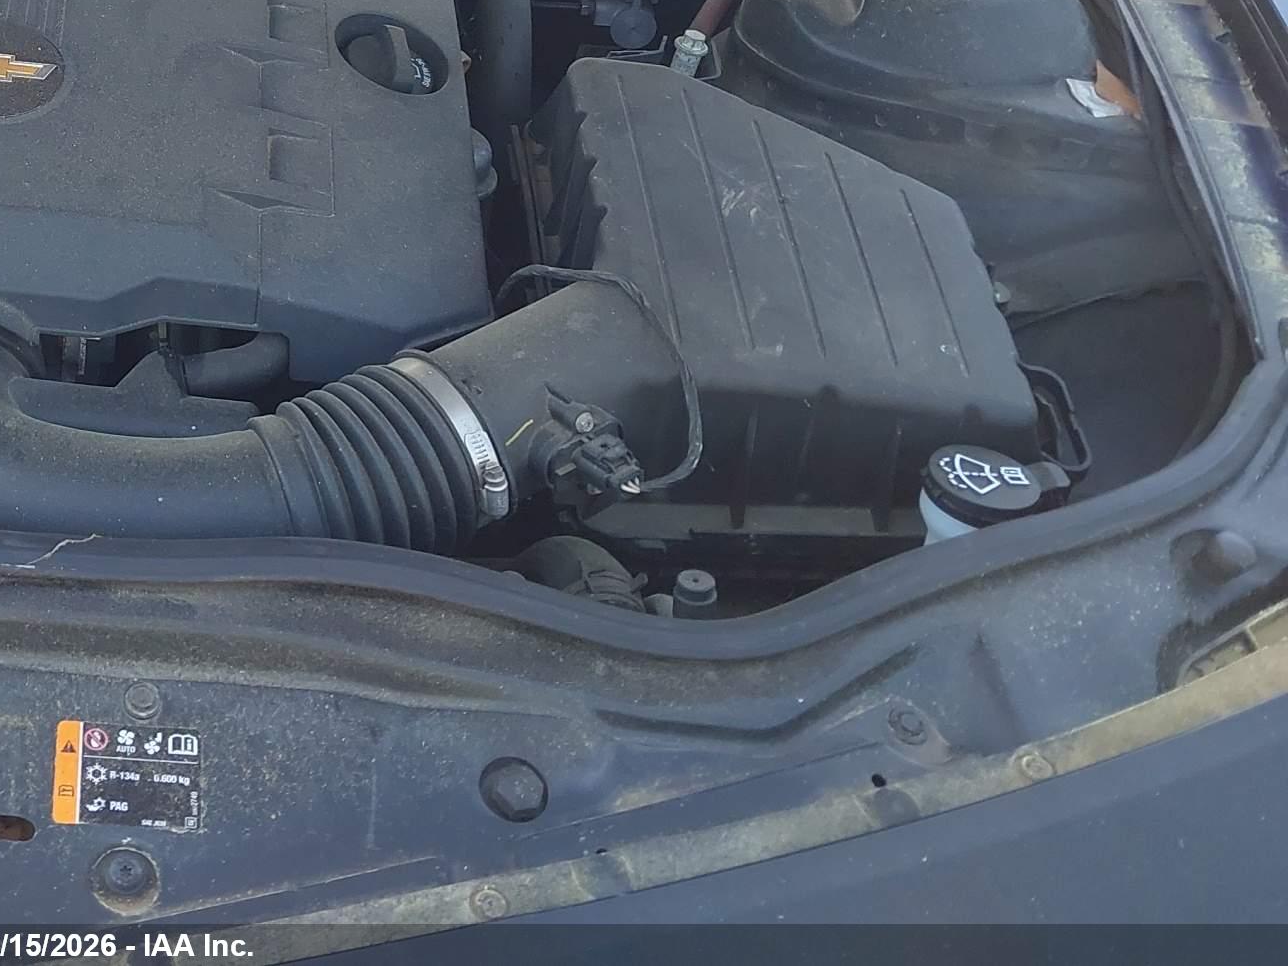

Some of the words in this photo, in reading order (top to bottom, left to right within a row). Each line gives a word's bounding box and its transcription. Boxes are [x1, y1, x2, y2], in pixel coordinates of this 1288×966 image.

[116, 745, 136, 753] AUTO
[109, 771, 140, 781] R-134a
[179, 776, 191, 786] kg
[109, 801, 129, 811] PAG
